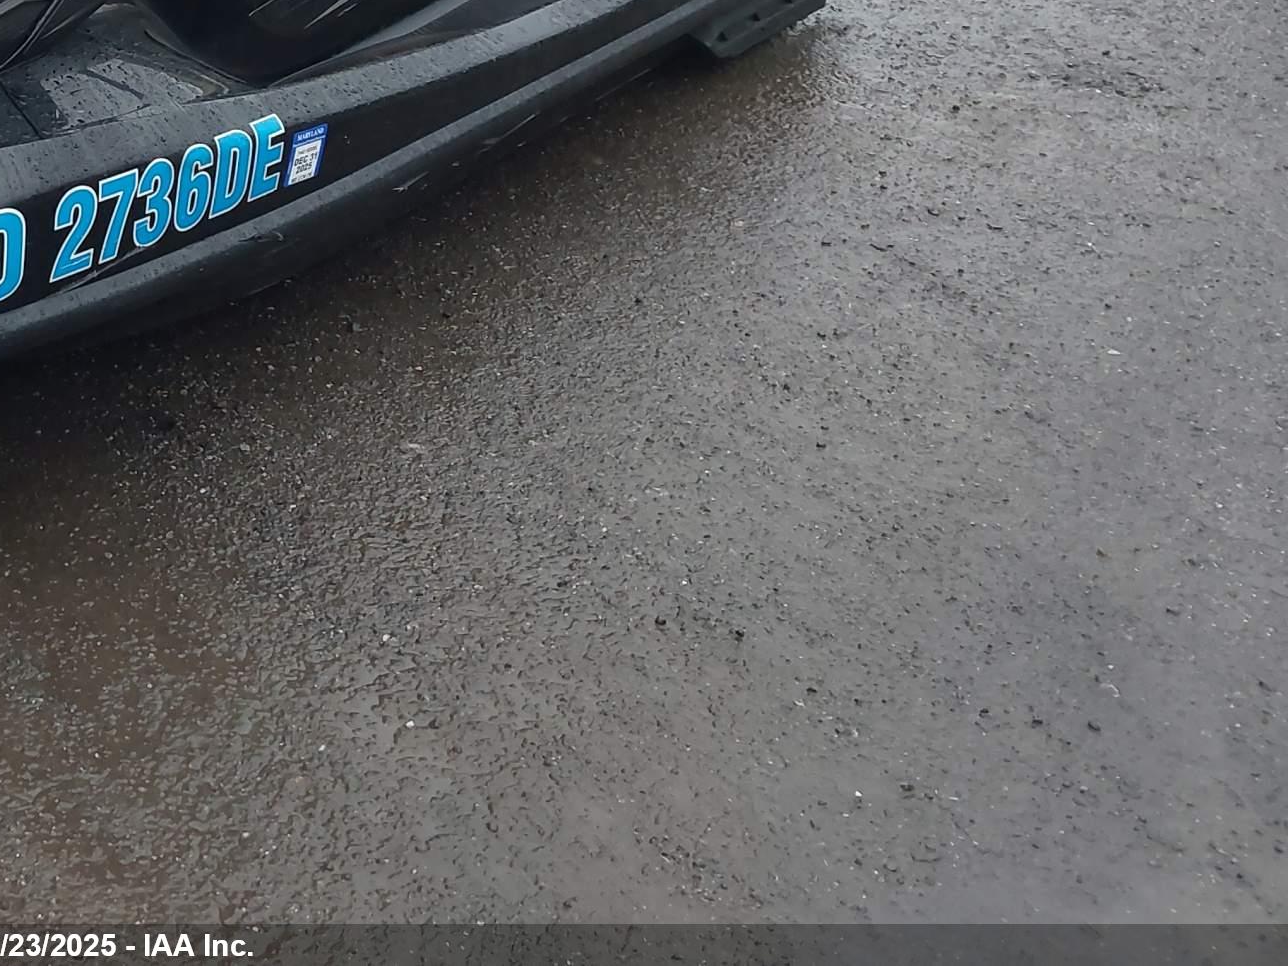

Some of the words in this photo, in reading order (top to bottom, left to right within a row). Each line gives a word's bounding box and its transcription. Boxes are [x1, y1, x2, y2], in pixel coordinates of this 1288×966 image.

[296, 126, 324, 141] MARYLAND
[294, 155, 309, 167] DEC
[49, 113, 286, 283] 2736DE
